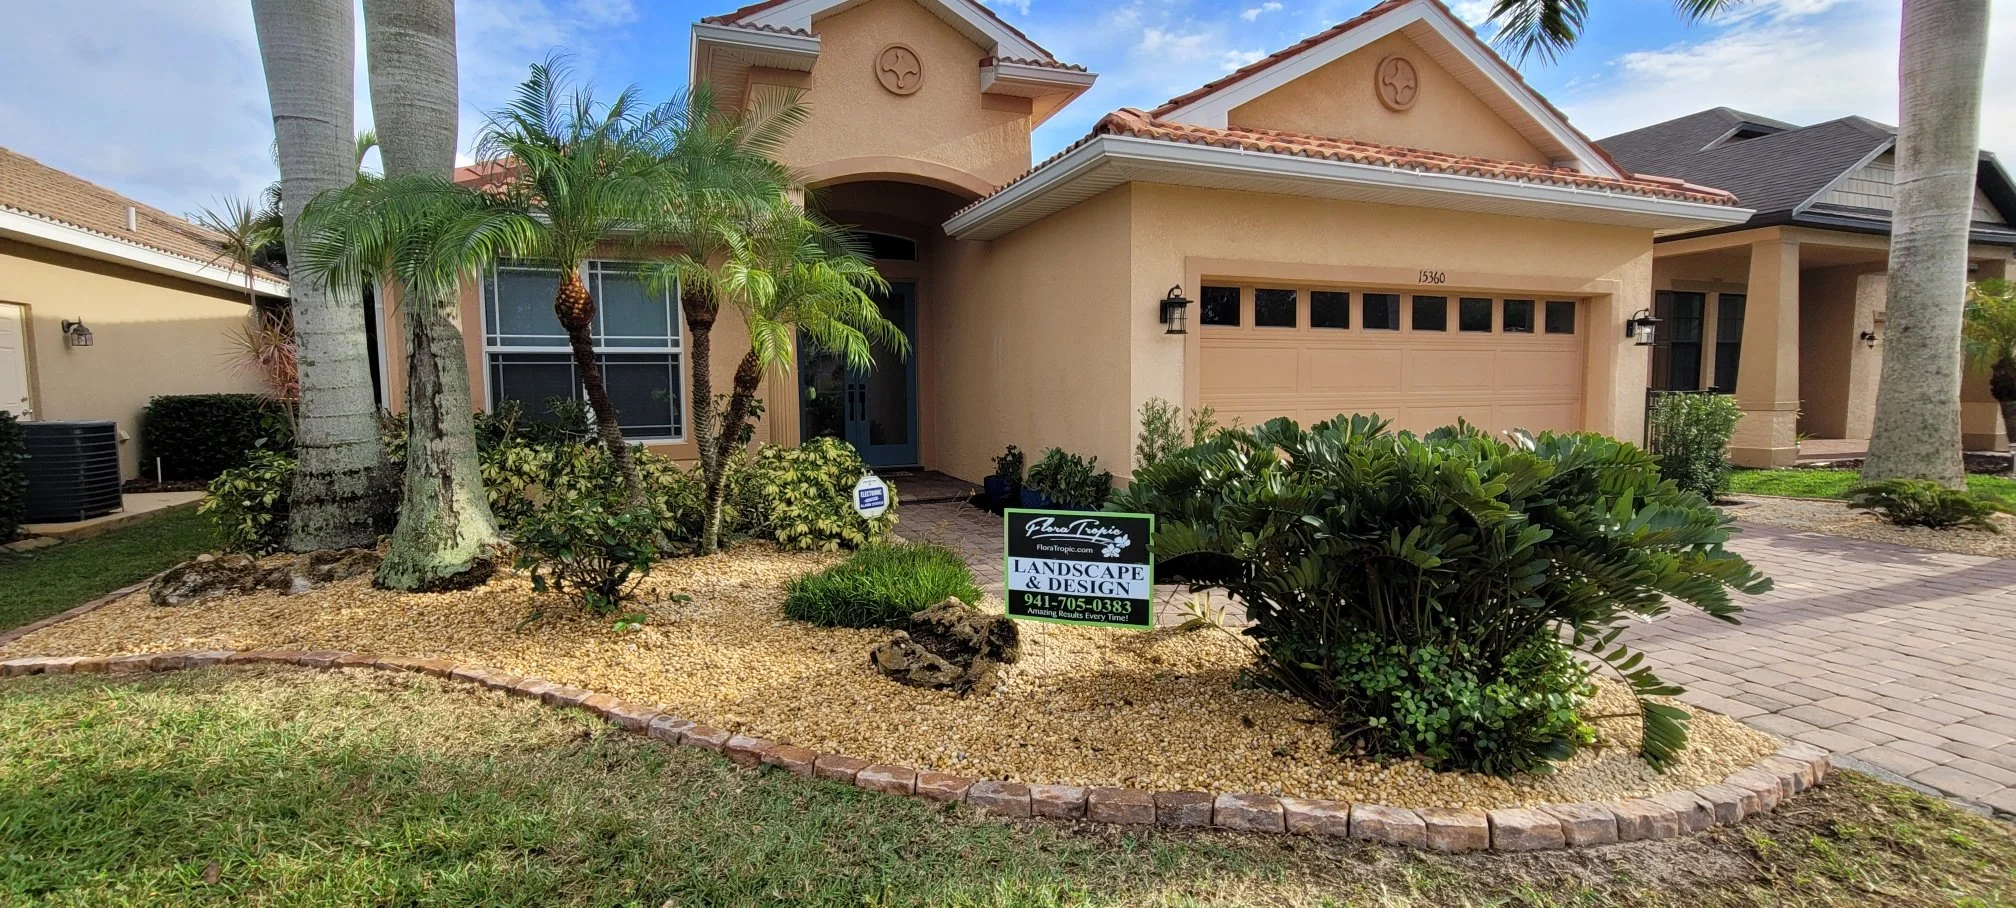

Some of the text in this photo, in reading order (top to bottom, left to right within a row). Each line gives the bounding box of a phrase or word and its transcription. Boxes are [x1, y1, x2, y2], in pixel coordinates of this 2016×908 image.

[1418, 270, 1446, 284] 15360
[1036, 544, 1093, 554] FloraTropic.com
[1014, 559, 1144, 581] LANDSCAPE
[1026, 576, 1131, 595] & DESIGN
[1024, 594, 1132, 614] 941-705-0383
[1027, 607, 1129, 622] Amazing Results Every Time!
